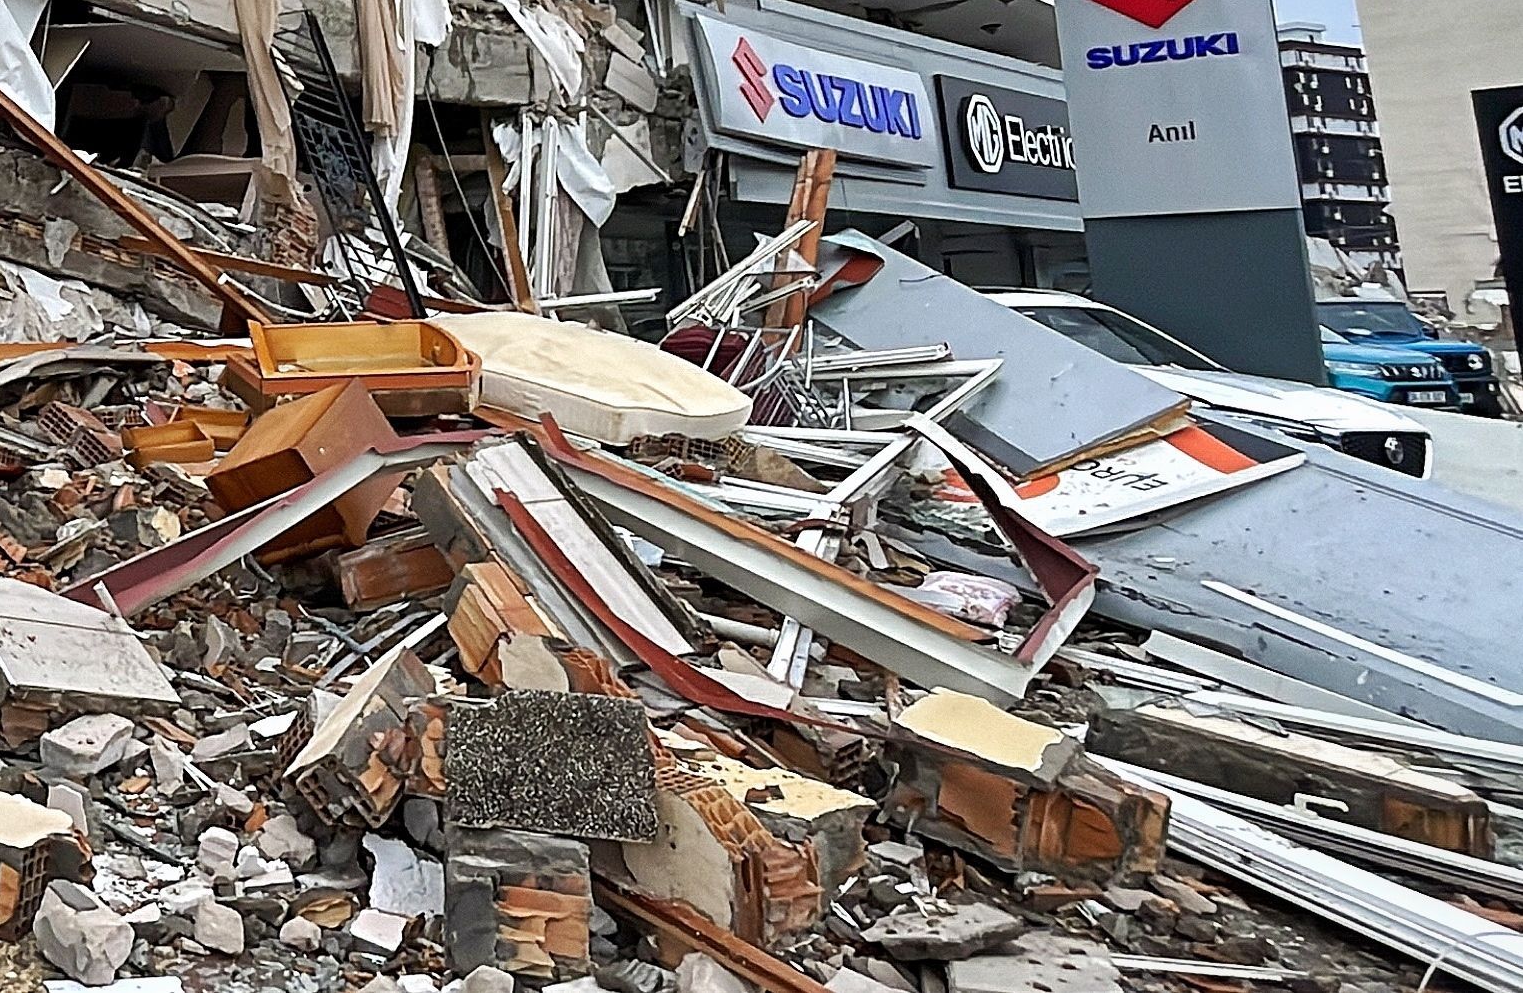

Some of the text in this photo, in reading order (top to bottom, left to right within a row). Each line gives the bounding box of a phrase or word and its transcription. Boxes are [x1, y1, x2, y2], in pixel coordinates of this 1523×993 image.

[1086, 32, 1240, 70] SUZUKI
[772, 63, 922, 140] SUZUKI
[969, 101, 1001, 166] MG
[1503, 175, 1523, 194] E
